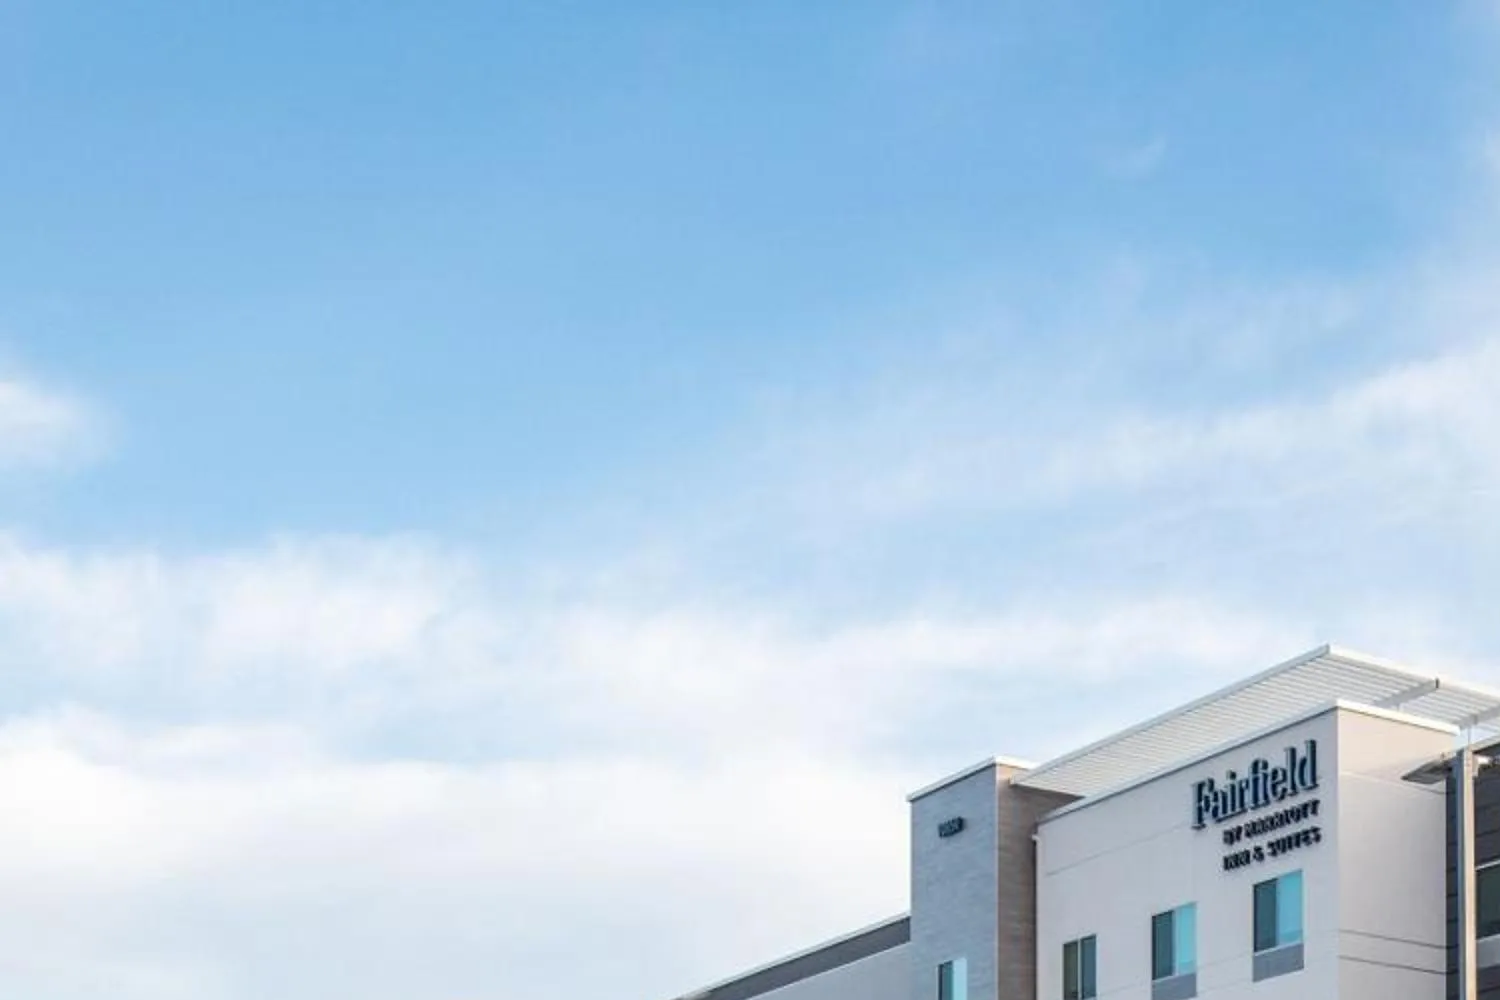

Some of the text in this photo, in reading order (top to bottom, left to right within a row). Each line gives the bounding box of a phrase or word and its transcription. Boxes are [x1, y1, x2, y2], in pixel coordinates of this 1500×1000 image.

[1191, 739, 1319, 830] Fairfield
[1223, 826, 1322, 870] INN & SUITES
